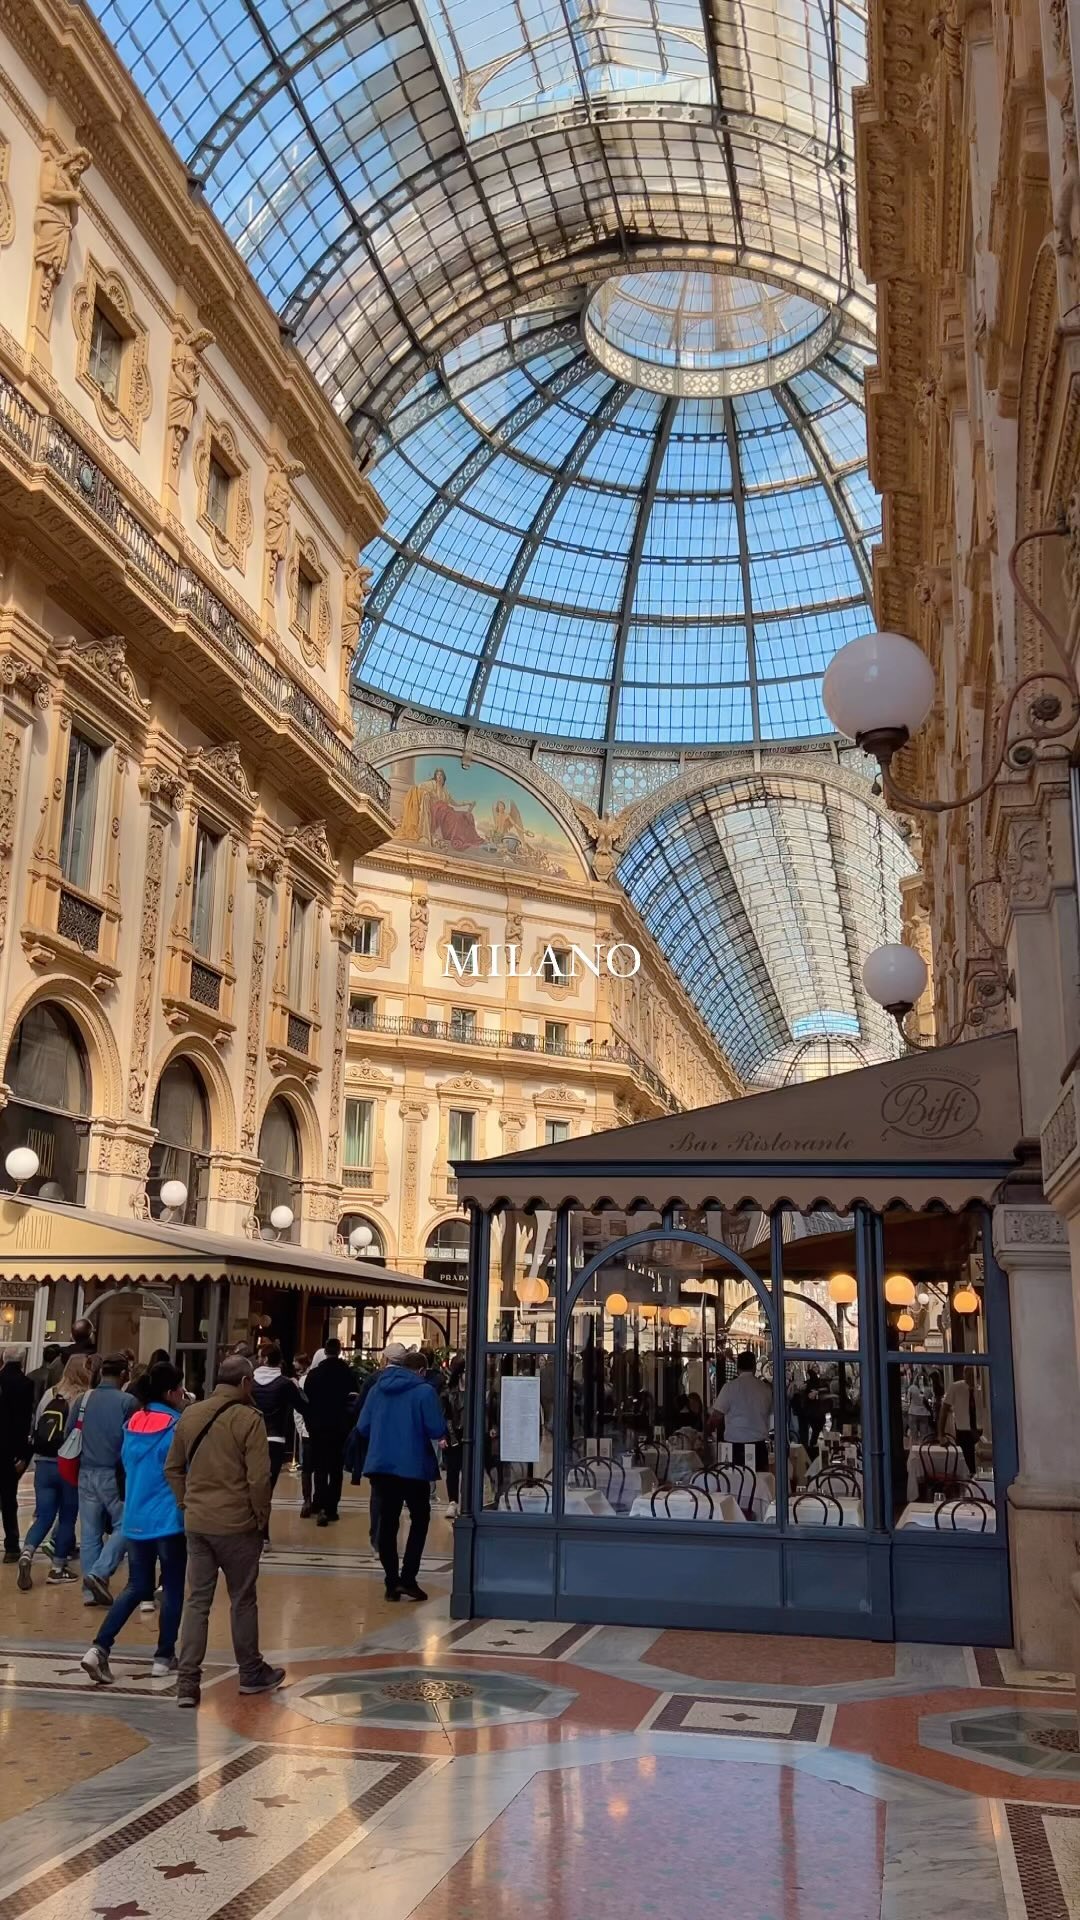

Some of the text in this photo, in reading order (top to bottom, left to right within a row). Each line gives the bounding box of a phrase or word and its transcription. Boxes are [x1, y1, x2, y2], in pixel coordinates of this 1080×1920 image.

[884, 1083, 967, 1136] Biffi
[669, 1131, 854, 1152] Bar Ristorante
